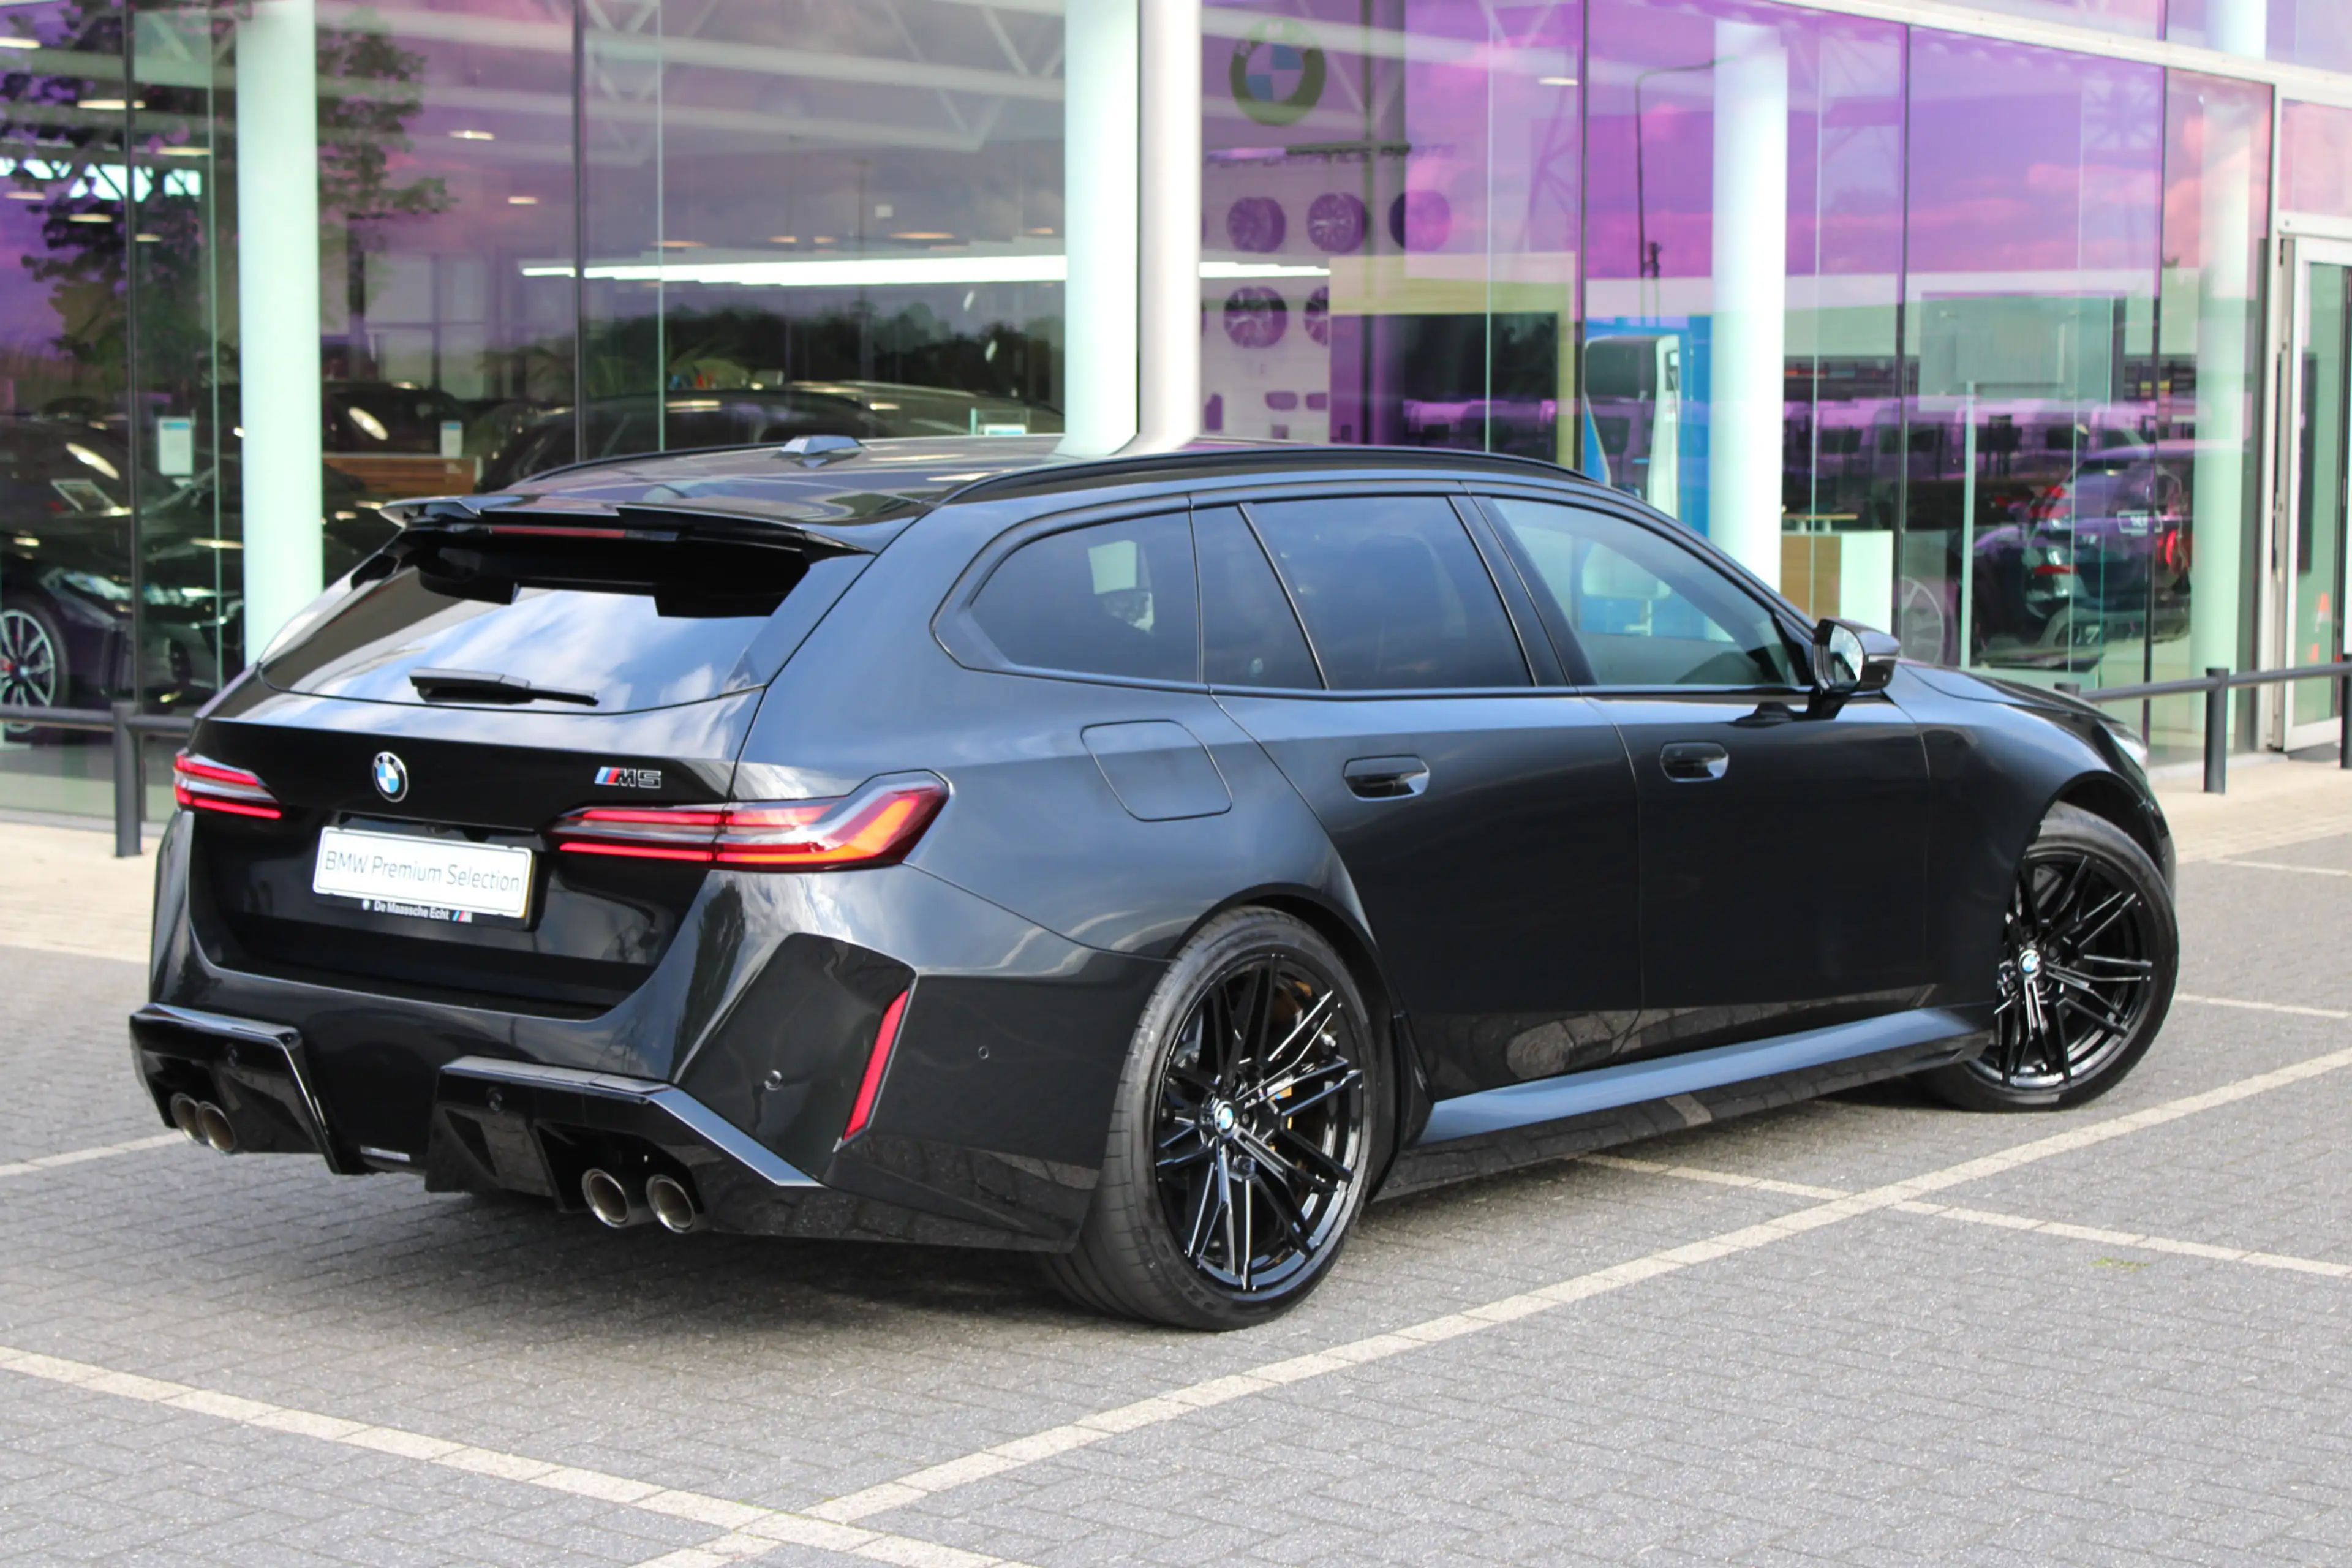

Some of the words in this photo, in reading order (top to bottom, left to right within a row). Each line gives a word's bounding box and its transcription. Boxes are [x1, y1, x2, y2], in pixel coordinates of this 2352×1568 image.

[614, 767, 662, 789] M5
[325, 850, 368, 874] BMW
[372, 856, 442, 883] Premium
[446, 864, 519, 892] Selection
[374, 900, 386, 913] De
[429, 907, 449, 921] Echt
